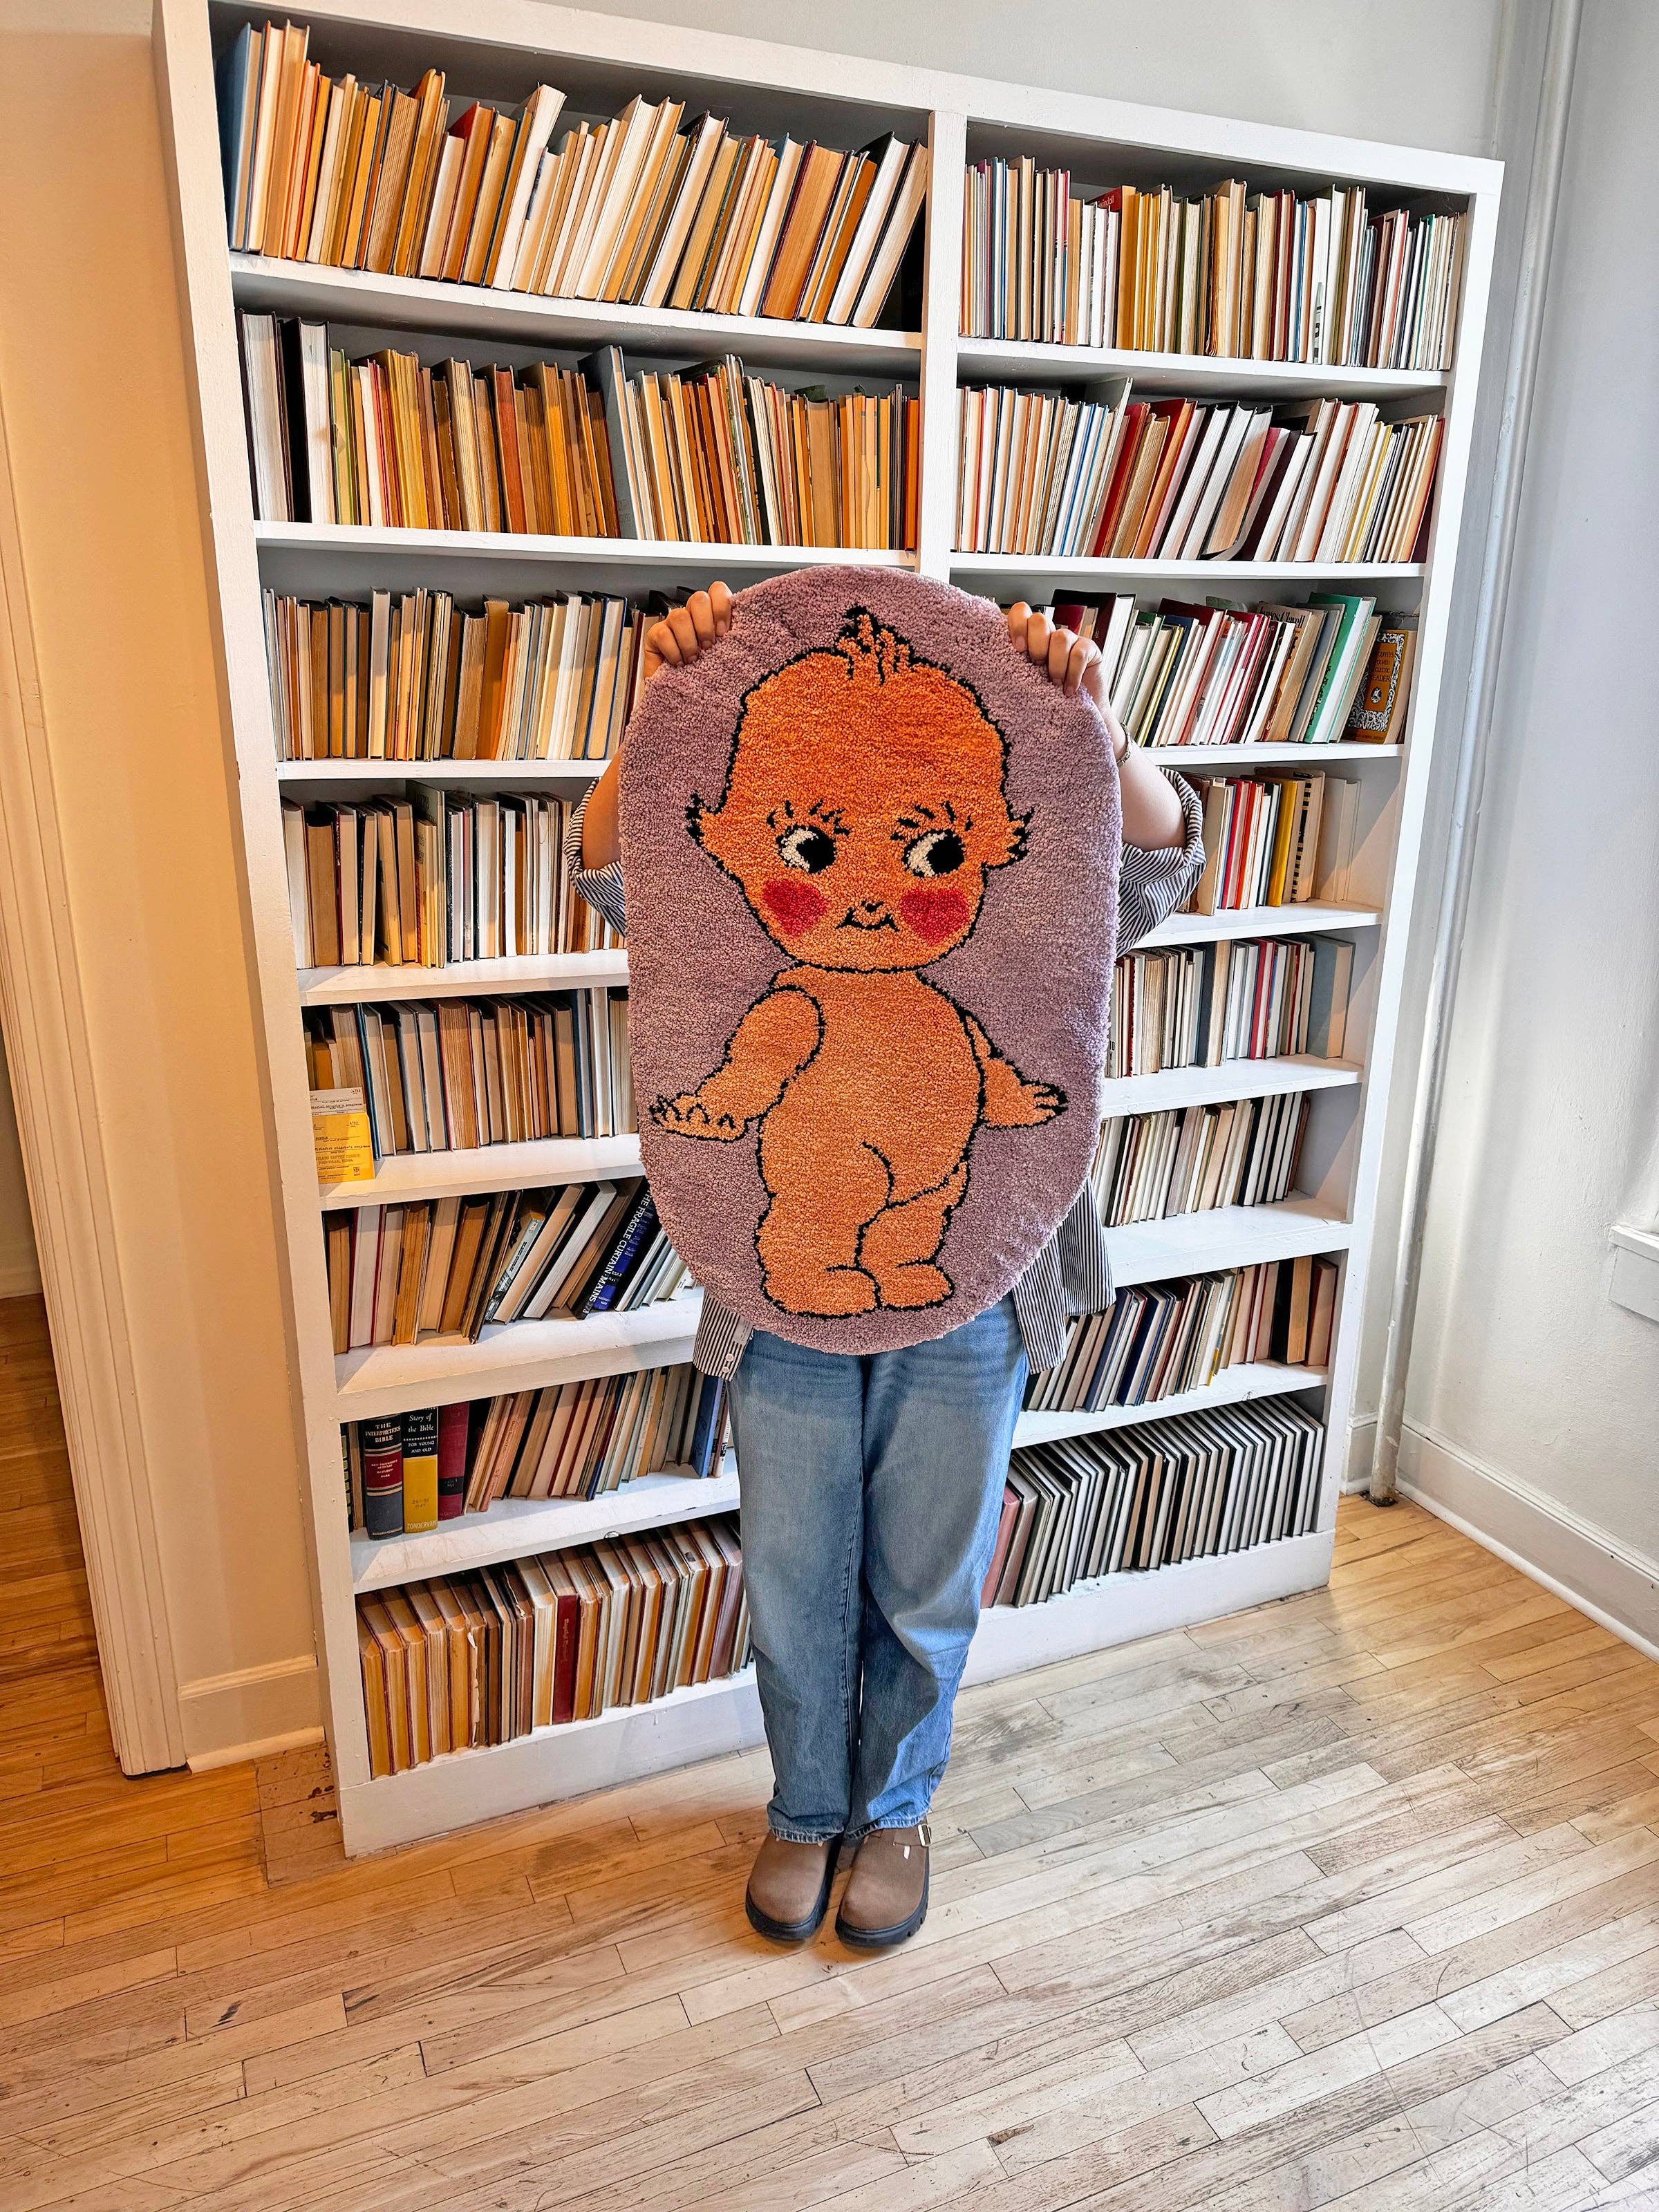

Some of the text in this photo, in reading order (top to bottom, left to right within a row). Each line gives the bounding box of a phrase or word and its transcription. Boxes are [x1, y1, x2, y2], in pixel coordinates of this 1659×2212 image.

[623, 1206, 646, 1240] FRAGILE
[605, 1239, 627, 1275] CURTAIN
[589, 1275, 608, 1302] MAINS
[426, 1413, 433, 1422] of
[420, 1423, 434, 1432] Bible
[406, 1520, 436, 1530] ZONDERVAN
